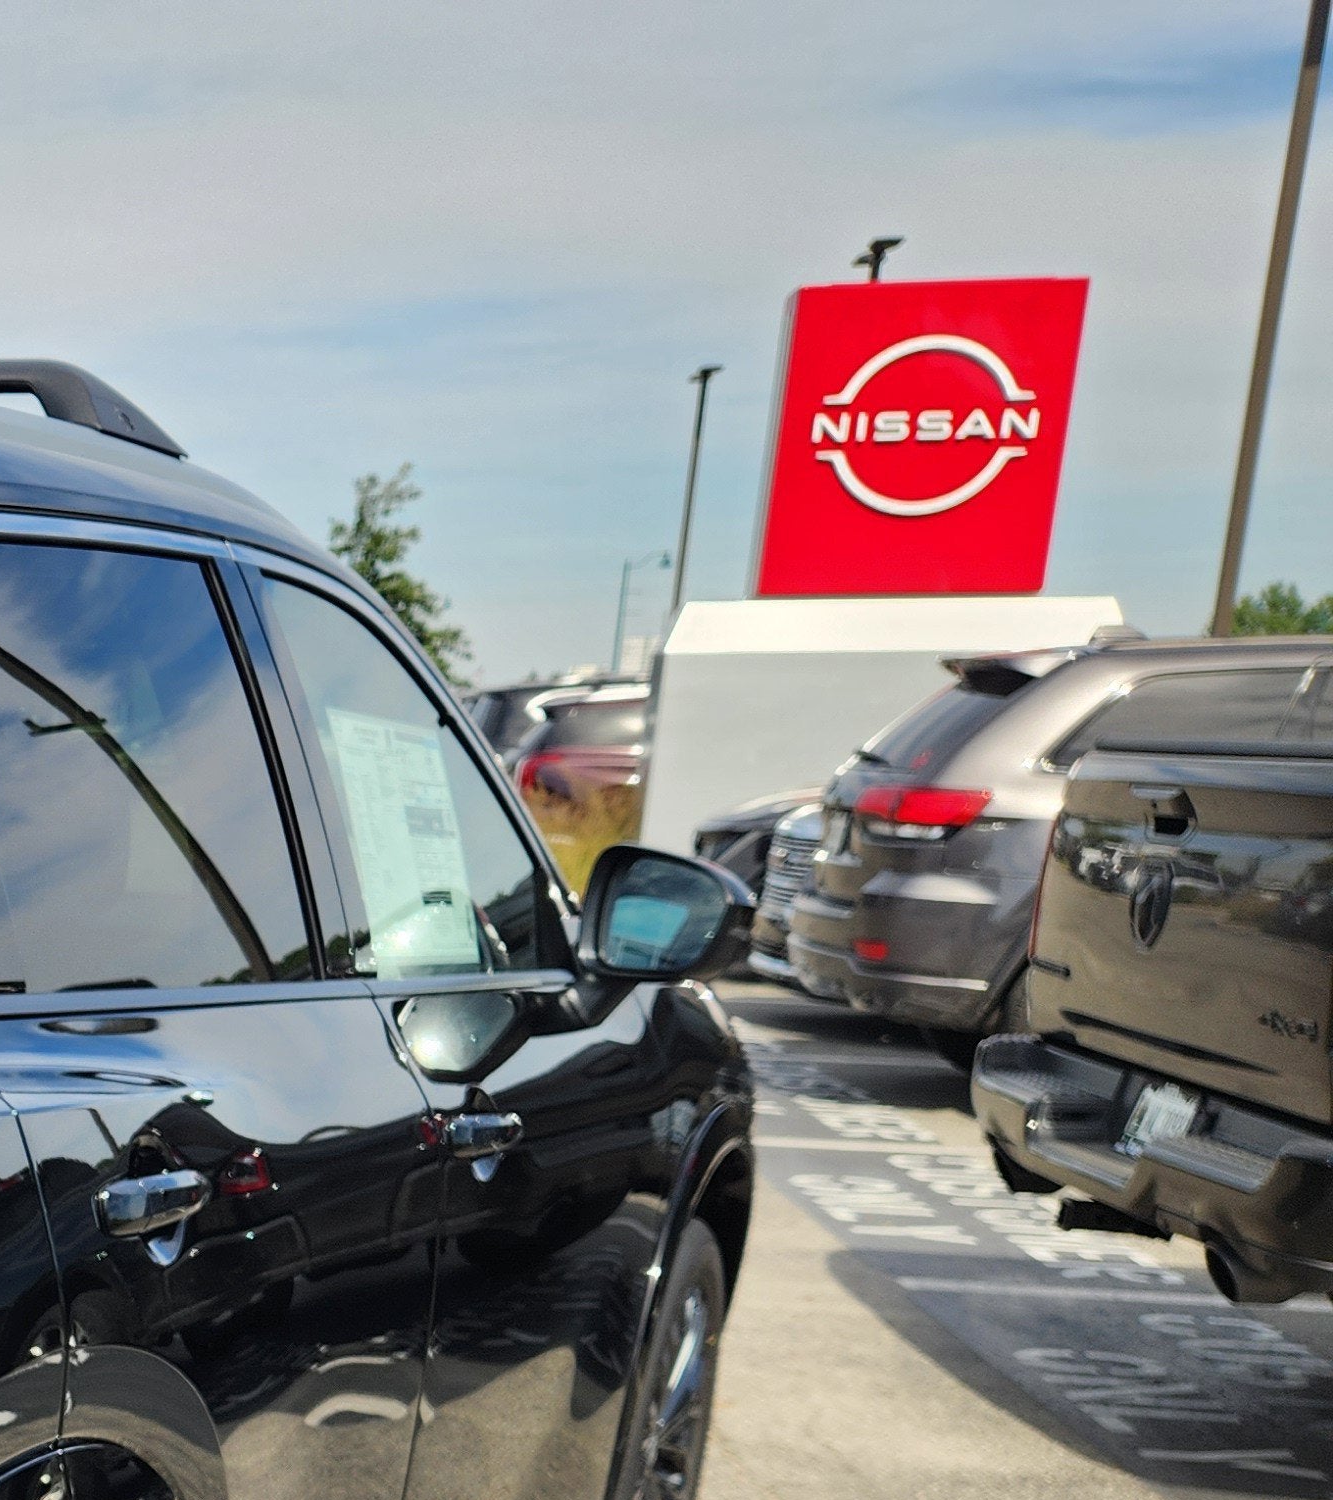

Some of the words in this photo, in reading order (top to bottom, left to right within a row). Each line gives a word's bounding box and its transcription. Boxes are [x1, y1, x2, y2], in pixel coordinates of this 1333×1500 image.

[811, 408, 1040, 444] NISSAN
[788, 1173, 979, 1246] ONLY
[1013, 1346, 1330, 1482] ONLY
